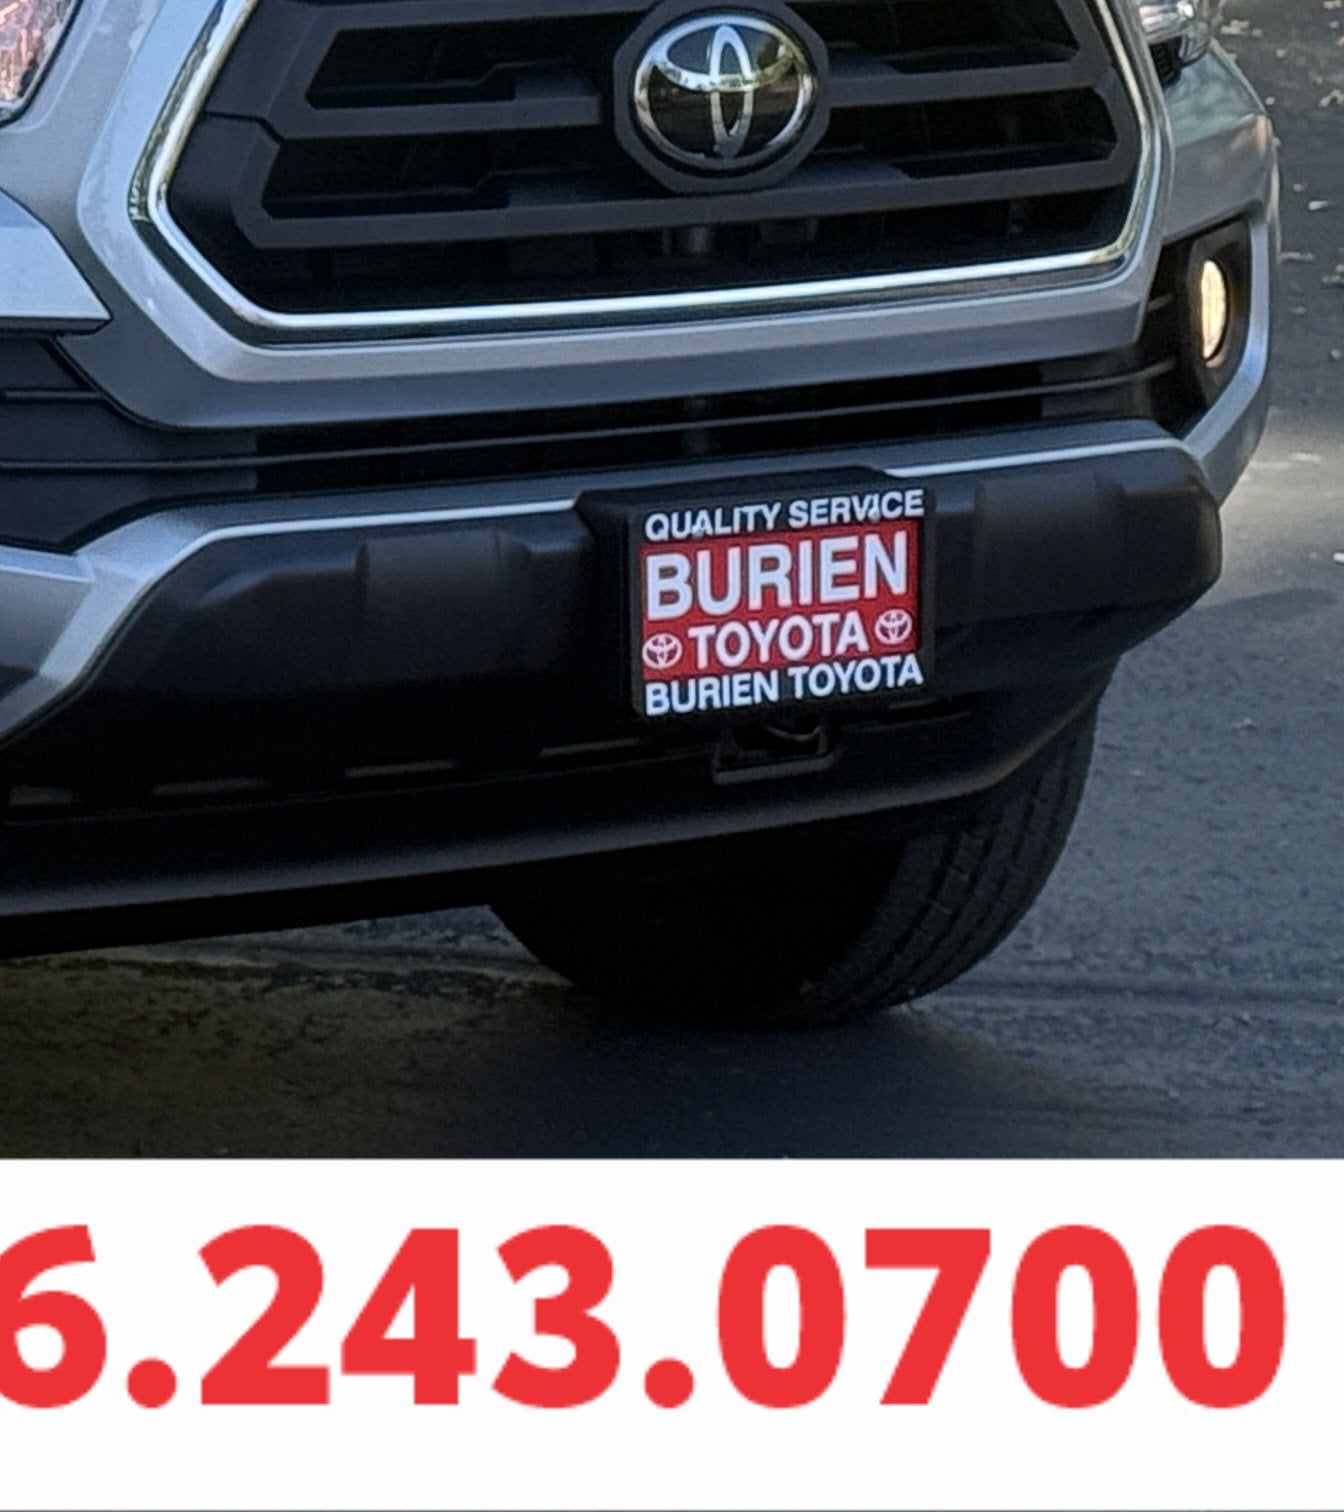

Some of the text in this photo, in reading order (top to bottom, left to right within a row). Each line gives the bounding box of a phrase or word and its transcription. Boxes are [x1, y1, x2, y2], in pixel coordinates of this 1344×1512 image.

[644, 488, 925, 542] QUALITY SERVICE
[645, 529, 909, 622] BURIEN
[687, 609, 870, 671] TOYOTA
[644, 653, 925, 717] BURIEN TOYOTA
